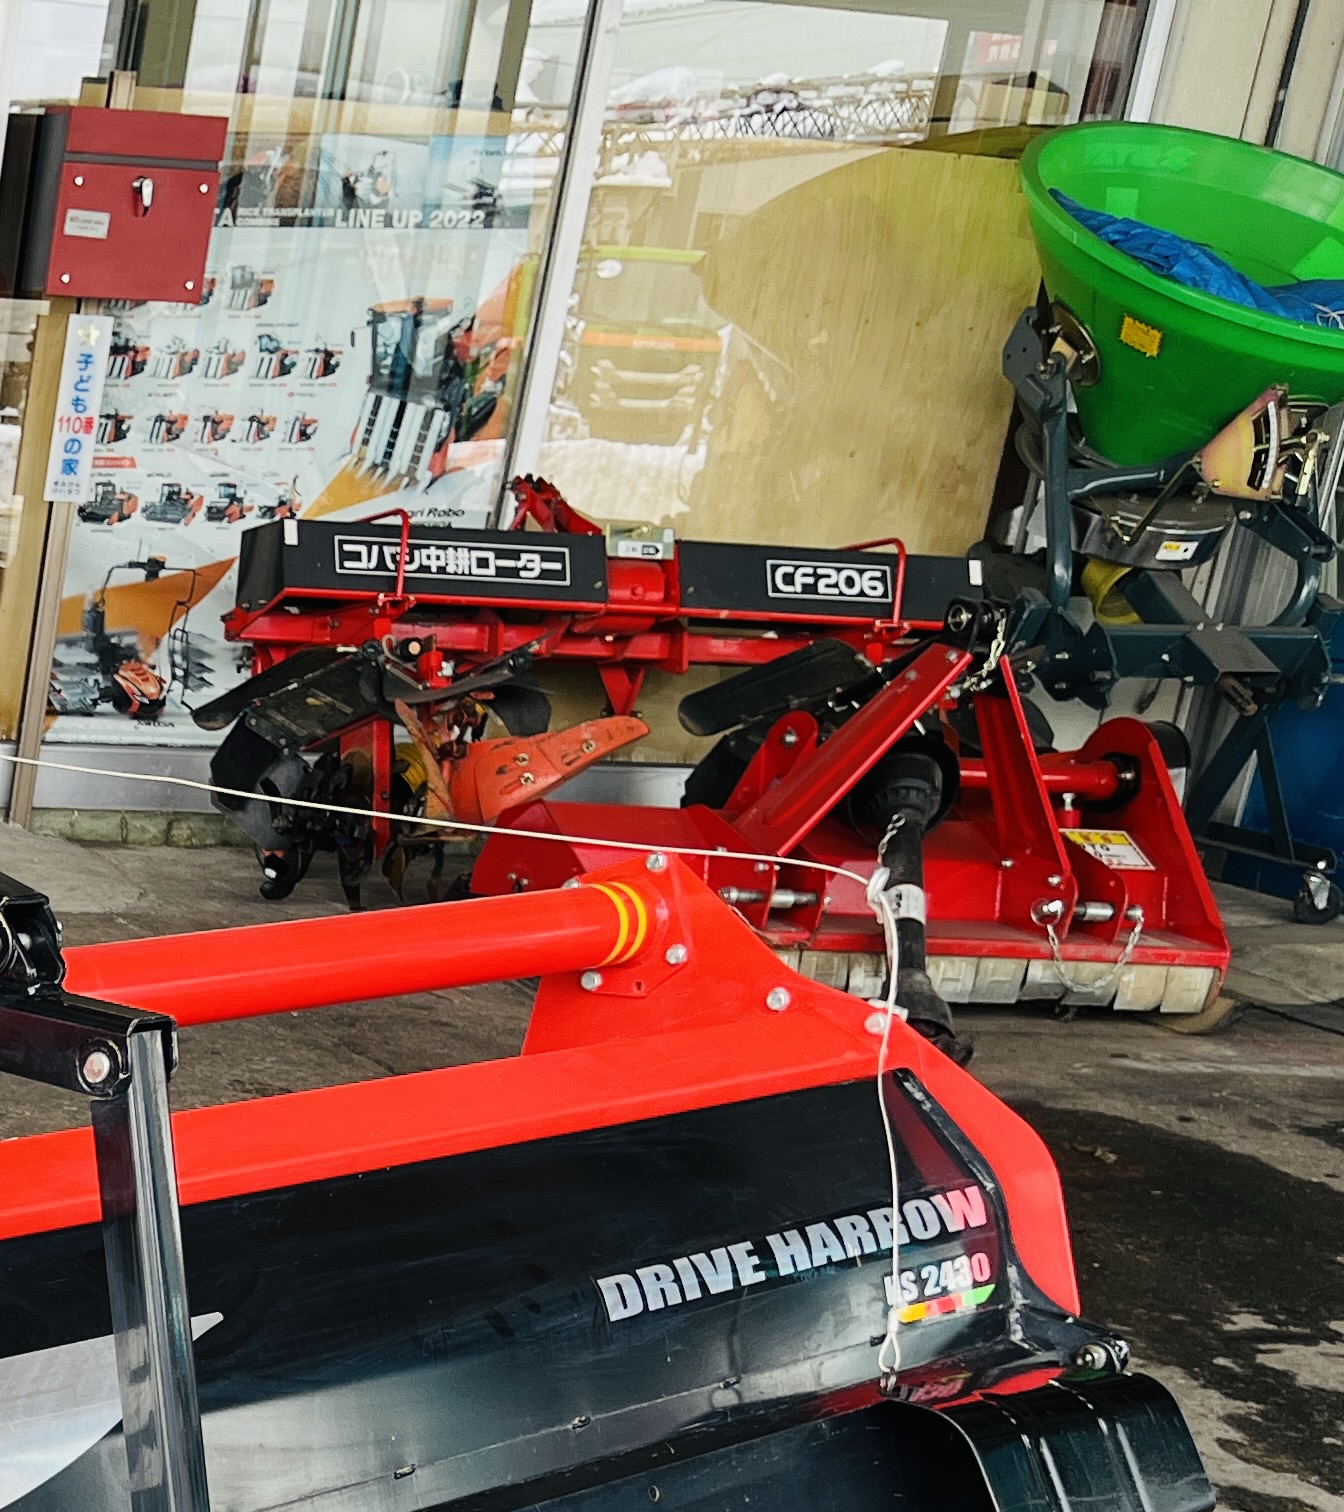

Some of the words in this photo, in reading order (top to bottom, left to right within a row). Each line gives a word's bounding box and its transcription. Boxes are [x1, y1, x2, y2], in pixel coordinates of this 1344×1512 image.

[334, 207, 386, 228] LINE
[392, 208, 423, 229] UP
[429, 209, 486, 229] 2022
[774, 565, 885, 597] CF206
[597, 1241, 767, 1322] DRIVE
[766, 1185, 988, 1277] HARROW
[920, 1252, 992, 1297] 2430
